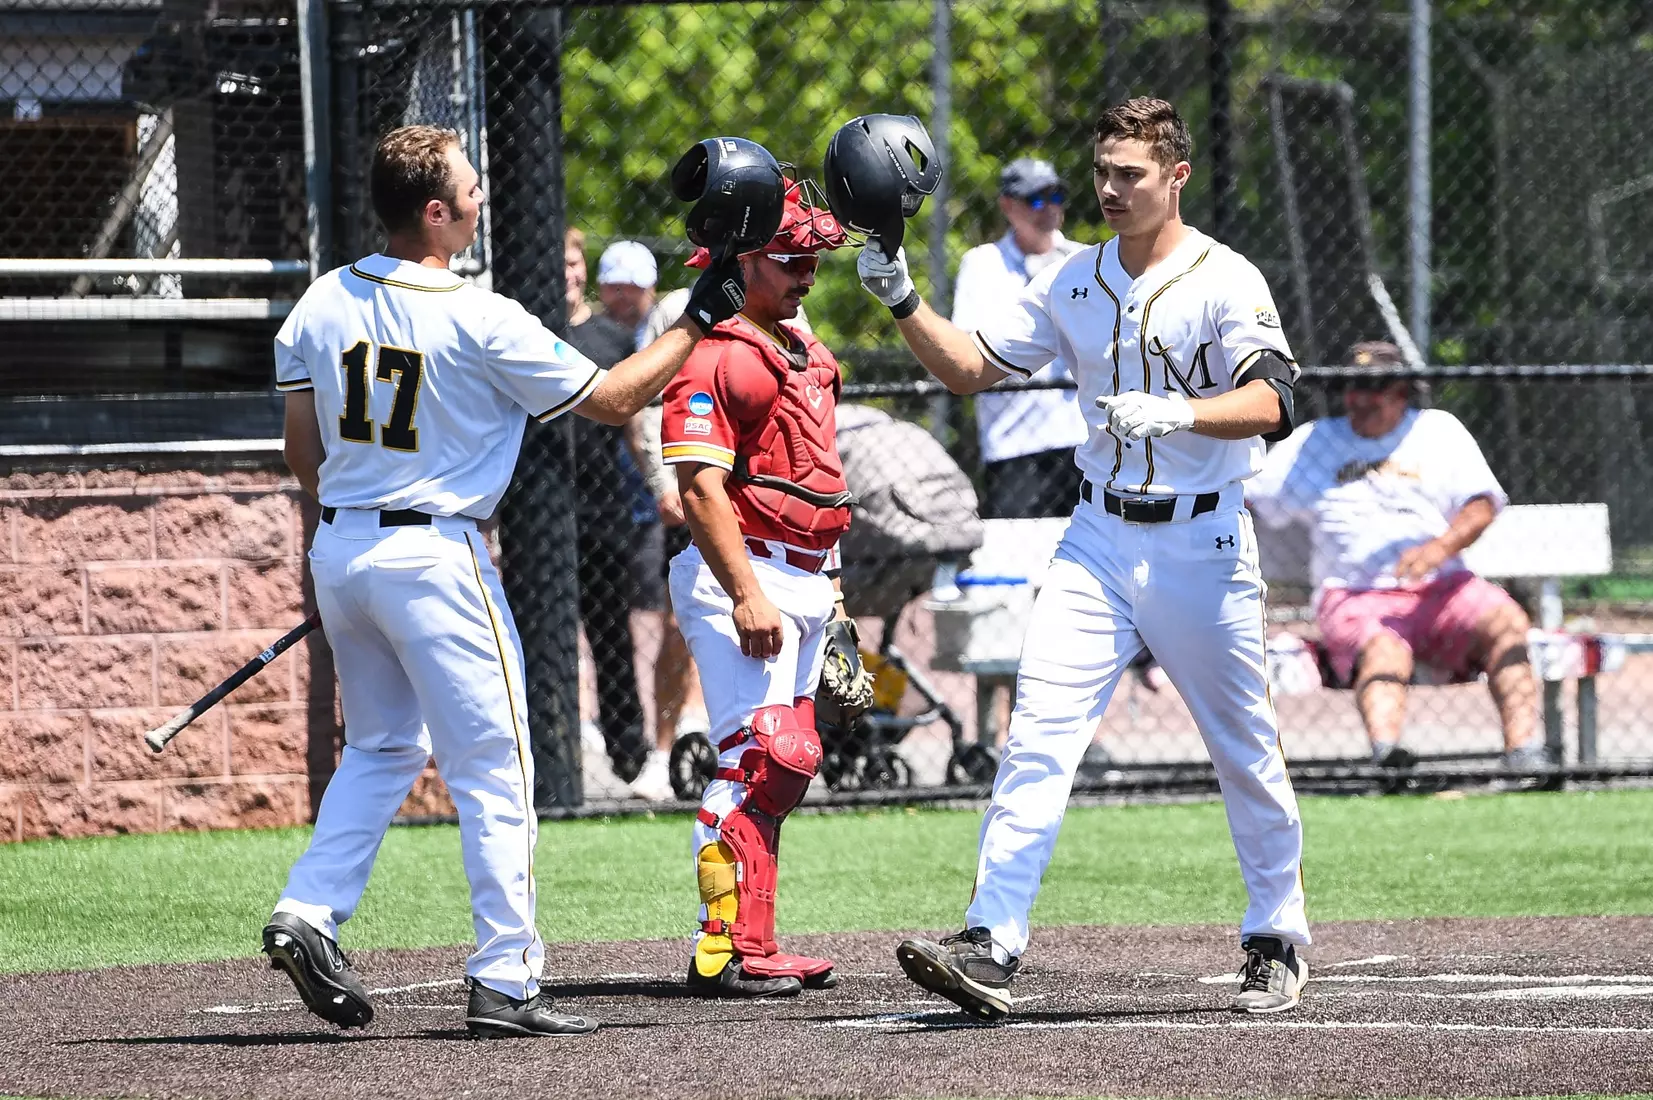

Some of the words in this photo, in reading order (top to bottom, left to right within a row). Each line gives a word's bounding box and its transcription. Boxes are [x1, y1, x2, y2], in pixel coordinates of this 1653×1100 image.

[885, 145, 906, 179] EVOSHIELD
[338, 340, 425, 452] 17
[685, 422, 710, 431] PSAC
